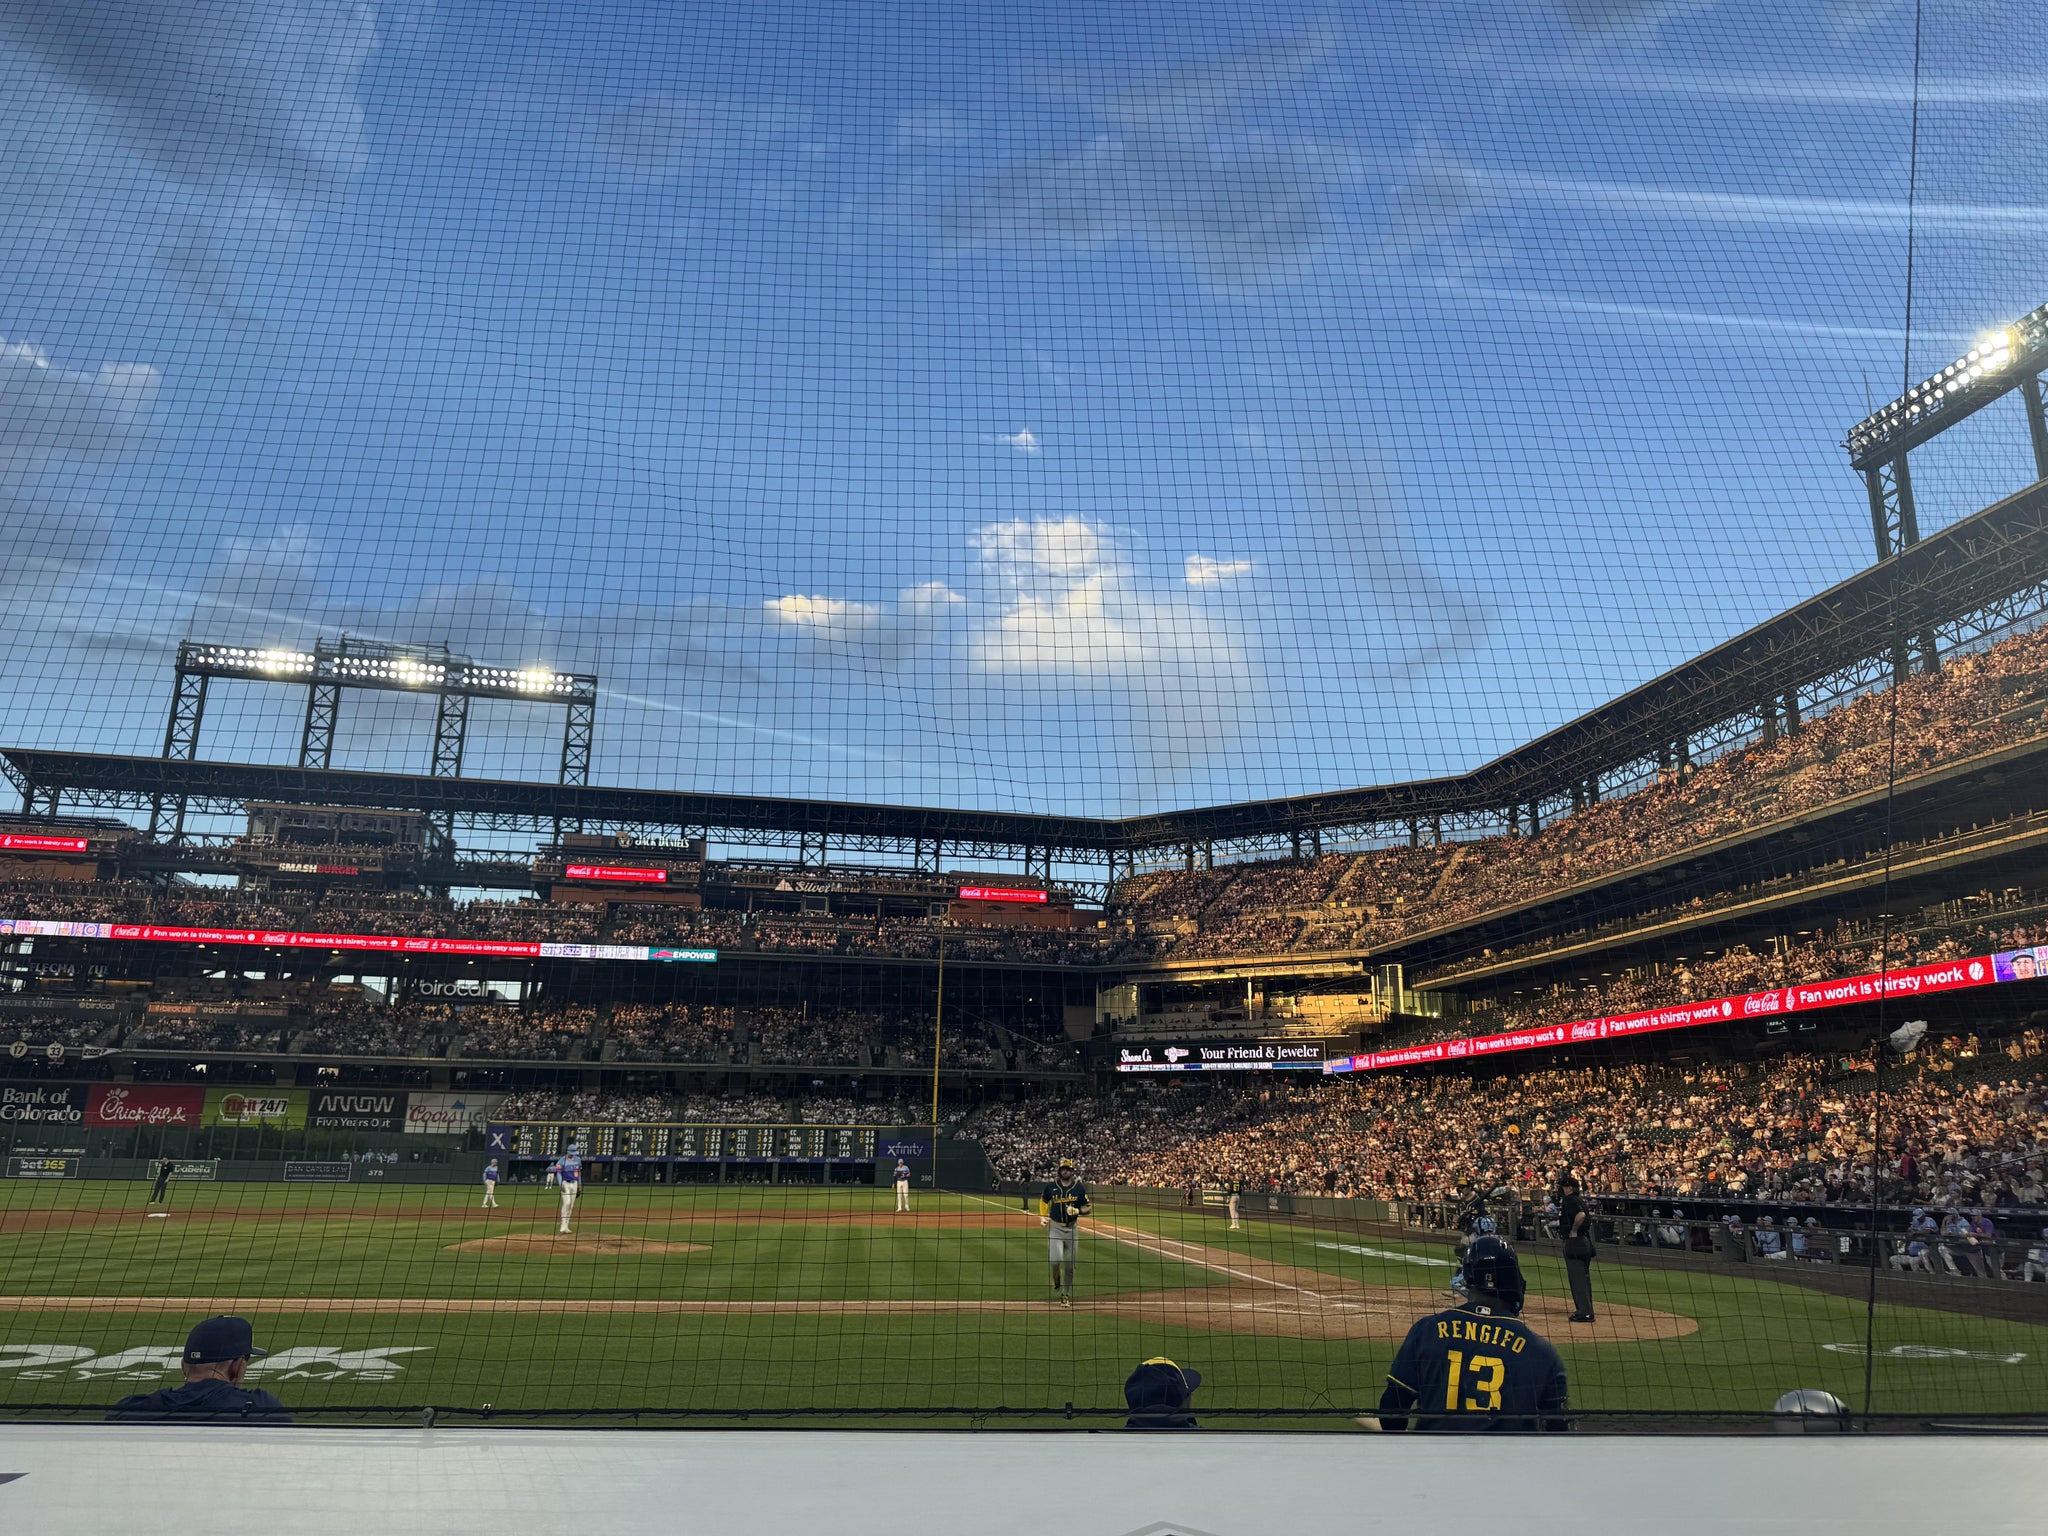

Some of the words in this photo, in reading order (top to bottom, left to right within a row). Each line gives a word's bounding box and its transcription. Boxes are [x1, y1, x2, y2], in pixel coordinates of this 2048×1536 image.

[278, 862, 359, 876] SMASHBURGER
[796, 881, 831, 893] Silver
[673, 951, 716, 960] EMPOWER
[1800, 989, 1822, 1003] Fan
[1824, 984, 1857, 1000] work
[1860, 980, 1871, 994] is
[1873, 972, 1921, 992] thirsty
[1923, 966, 1964, 985] work
[1610, 1020, 1626, 1032] Fan
[1627, 1018, 1649, 1029] work
[1651, 1015, 1658, 1026] is
[1660, 1011, 1691, 1024] thirsty
[1692, 1005, 1719, 1018] work
[1476, 1041, 1488, 1050] Fan
[1489, 1038, 1504, 1049] work
[1506, 1037, 1512, 1046] is
[1536, 1031, 1555, 1042] work
[13, 1045, 24, 1055] 17
[50, 1047, 60, 1056] 33
[1200, 1048, 1225, 1059] Your
[1227, 1046, 1263, 1059] Friend
[1265, 1046, 1274, 1058] &
[1277, 1045, 1319, 1060] Jeweler
[3, 1088, 46, 1104] Bank
[50, 1088, 70, 1104] of
[259, 1100, 287, 1112] 24/7
[0, 1105, 81, 1122] Colorado
[409, 1106, 457, 1123] Coors
[460, 1112, 498, 1122] LIGH
[316, 1118, 339, 1127] Five
[341, 1118, 369, 1128] Years
[887, 1142, 923, 1156] xfinity
[21, 1159, 66, 1169] bet365
[1438, 1320, 1526, 1354] RENGIFO
[9, 1370, 402, 1380] SYSEMS
[1446, 1350, 1505, 1411] 13
